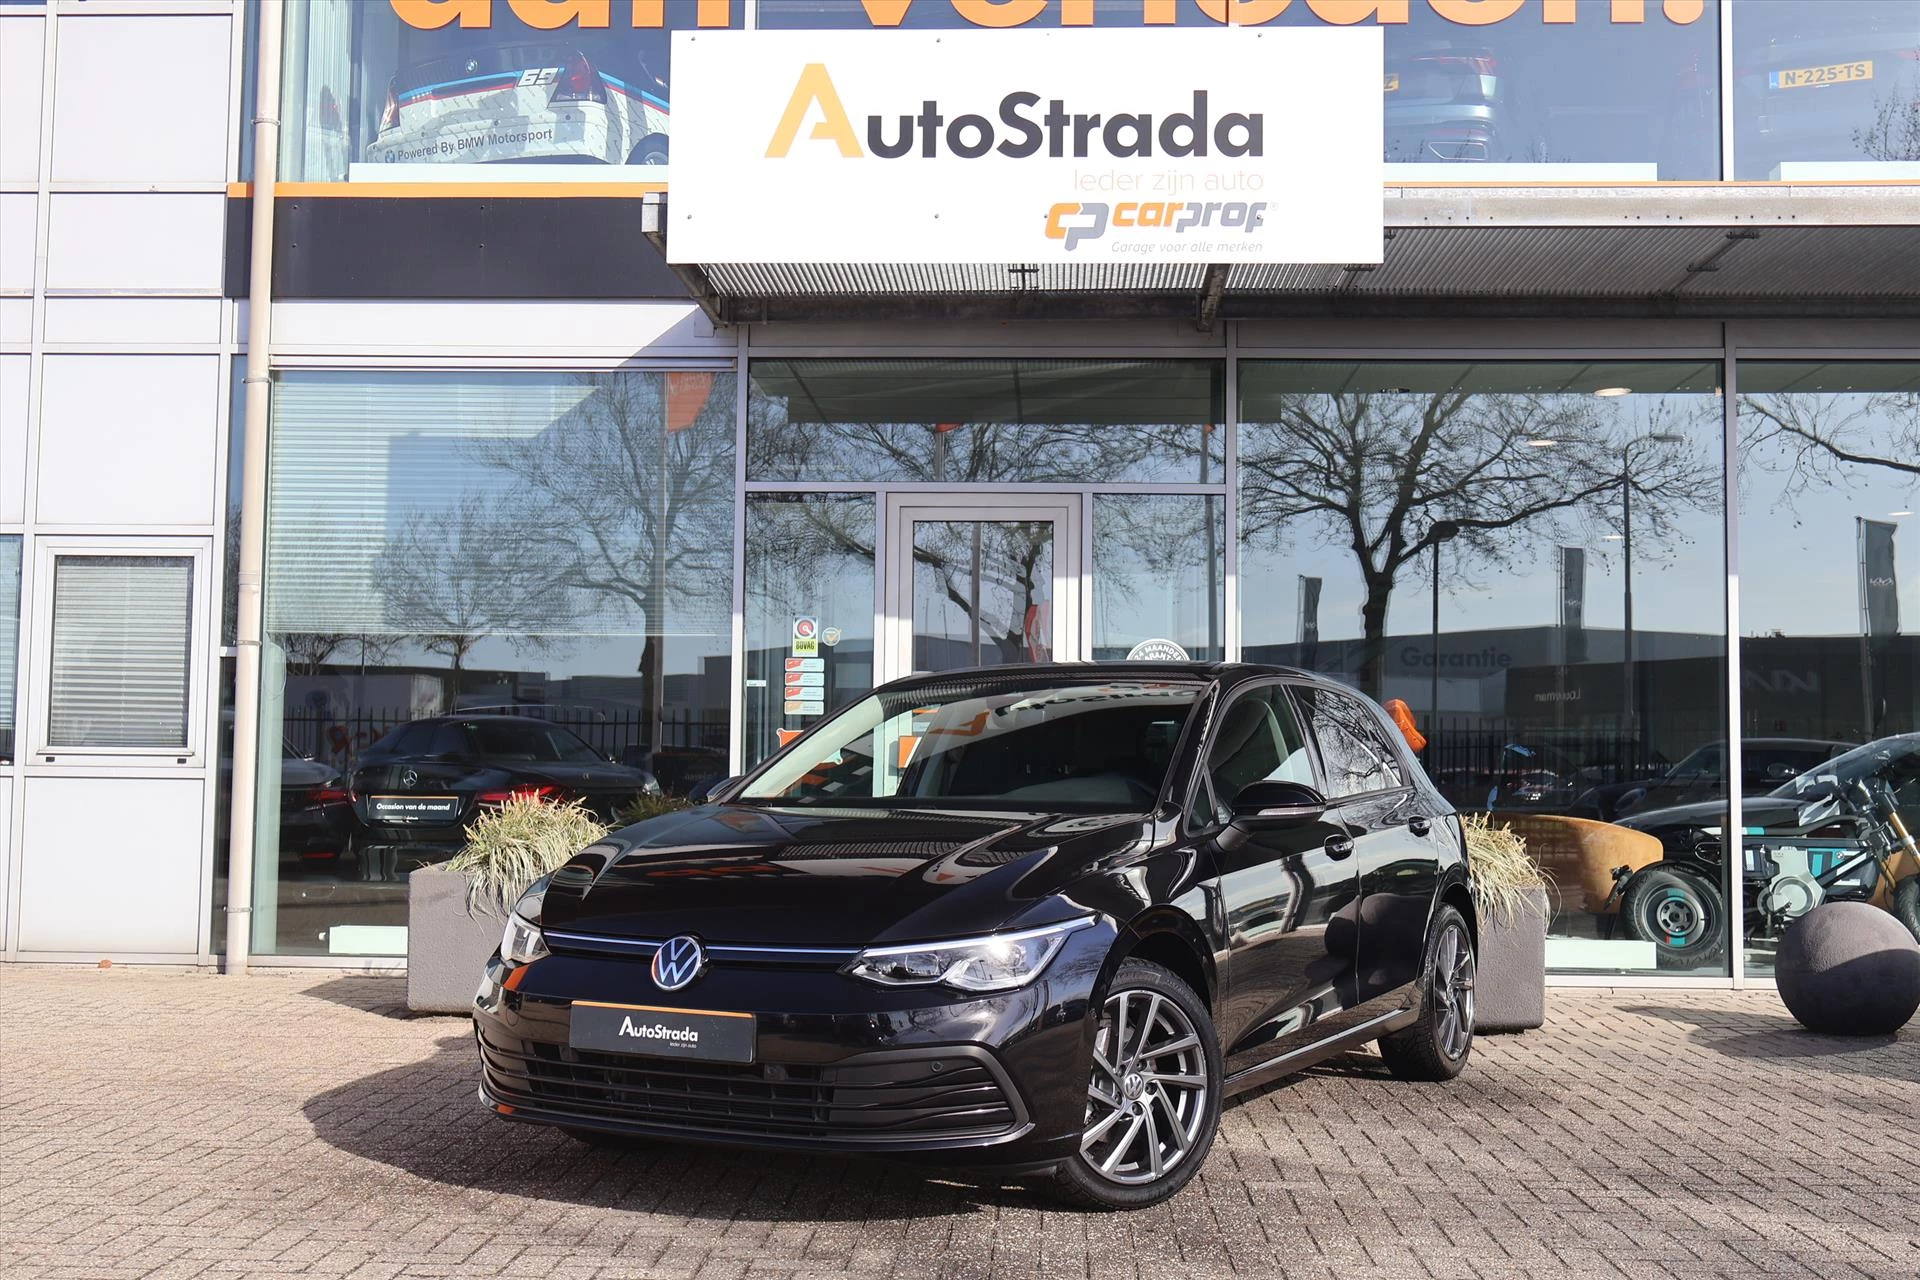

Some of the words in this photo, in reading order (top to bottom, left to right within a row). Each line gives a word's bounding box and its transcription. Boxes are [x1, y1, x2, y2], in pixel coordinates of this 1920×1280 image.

[518, 67, 559, 87] 69
[1784, 63, 1866, 85] N-225-TS
[764, 63, 1264, 159] AutoStrada
[397, 142, 438, 161] Powered
[440, 140, 455, 154] By
[457, 135, 485, 150] BMW
[487, 129, 553, 146] Motorsport
[1074, 169, 1144, 192] Ieder
[1152, 169, 1195, 197] zijn
[1204, 170, 1264, 192] auto
[1112, 202, 1267, 233] carprof
[1111, 241, 1156, 254] Garage
[1160, 243, 1187, 253] voor
[1190, 241, 1212, 253] alle
[1215, 241, 1264, 253] merken
[1400, 645, 1513, 668] Garantie
[376, 802, 404, 811] Occasion
[427, 803, 451, 811] maand
[618, 1015, 699, 1042] AutoStrada
